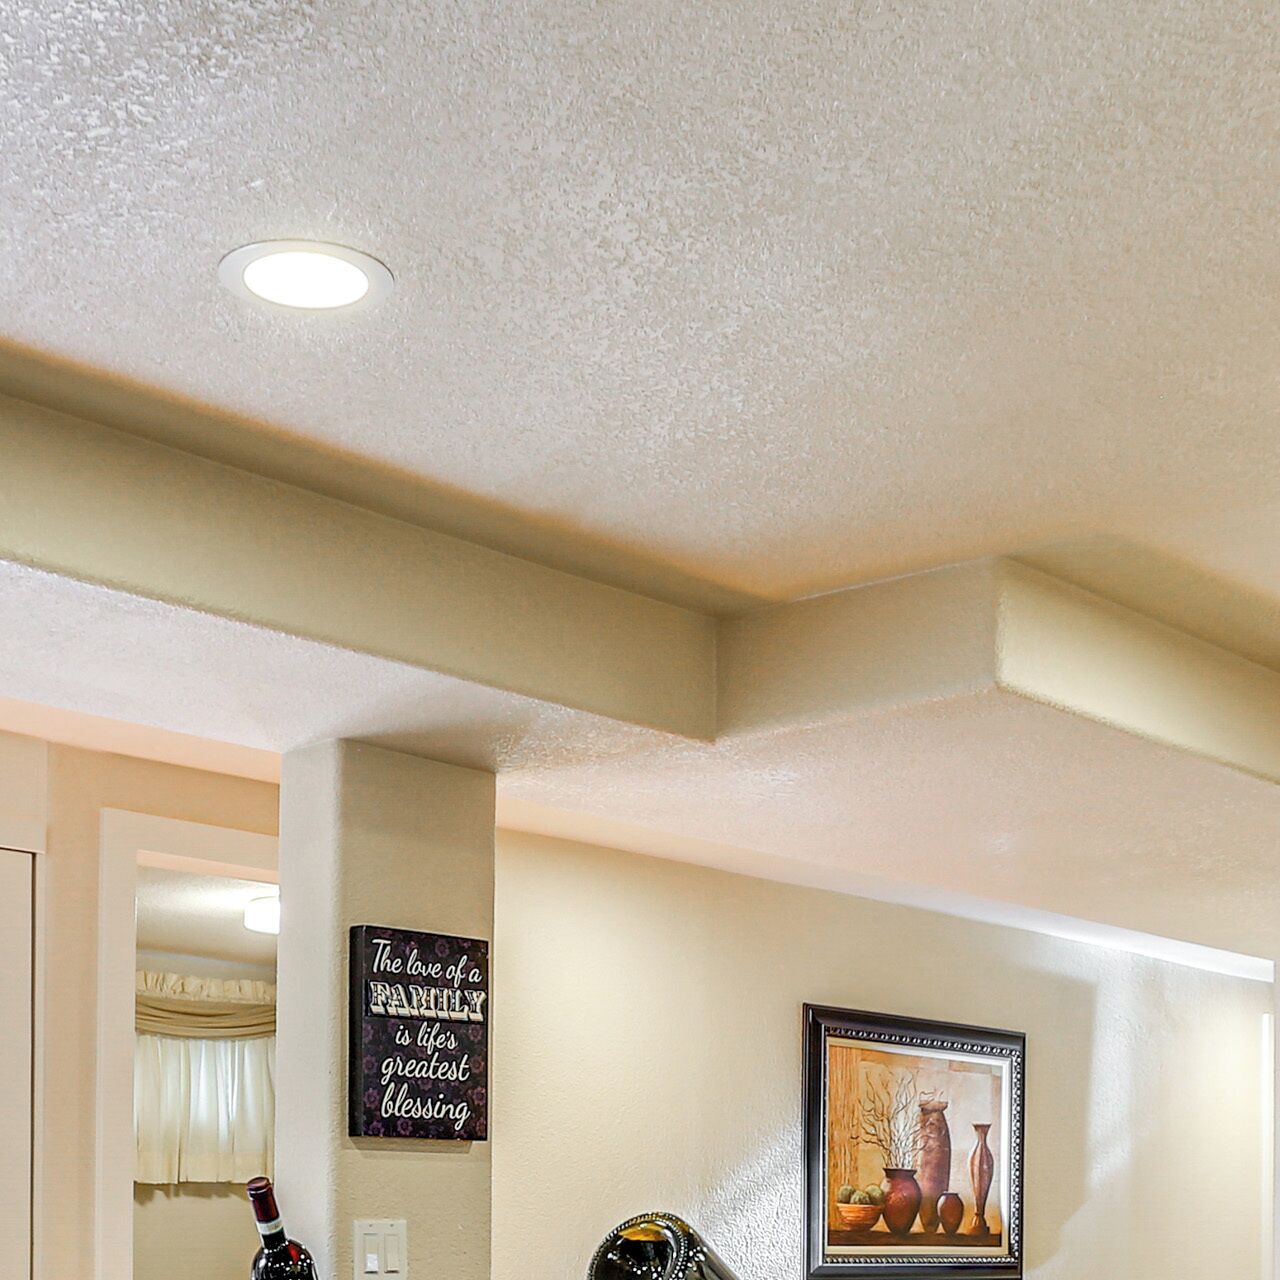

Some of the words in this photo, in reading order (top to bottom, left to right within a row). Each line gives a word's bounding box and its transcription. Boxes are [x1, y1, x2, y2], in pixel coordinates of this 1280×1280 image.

[371, 938, 404, 974] The
[406, 948, 443, 979] love
[445, 955, 466, 987] of
[468, 968, 483, 983] a
[369, 981, 487, 1021] FAMILY
[395, 1024, 413, 1047] is
[416, 1021, 458, 1054] life's
[381, 1052, 471, 1085] greatest
[381, 1082, 472, 1131] blessing
